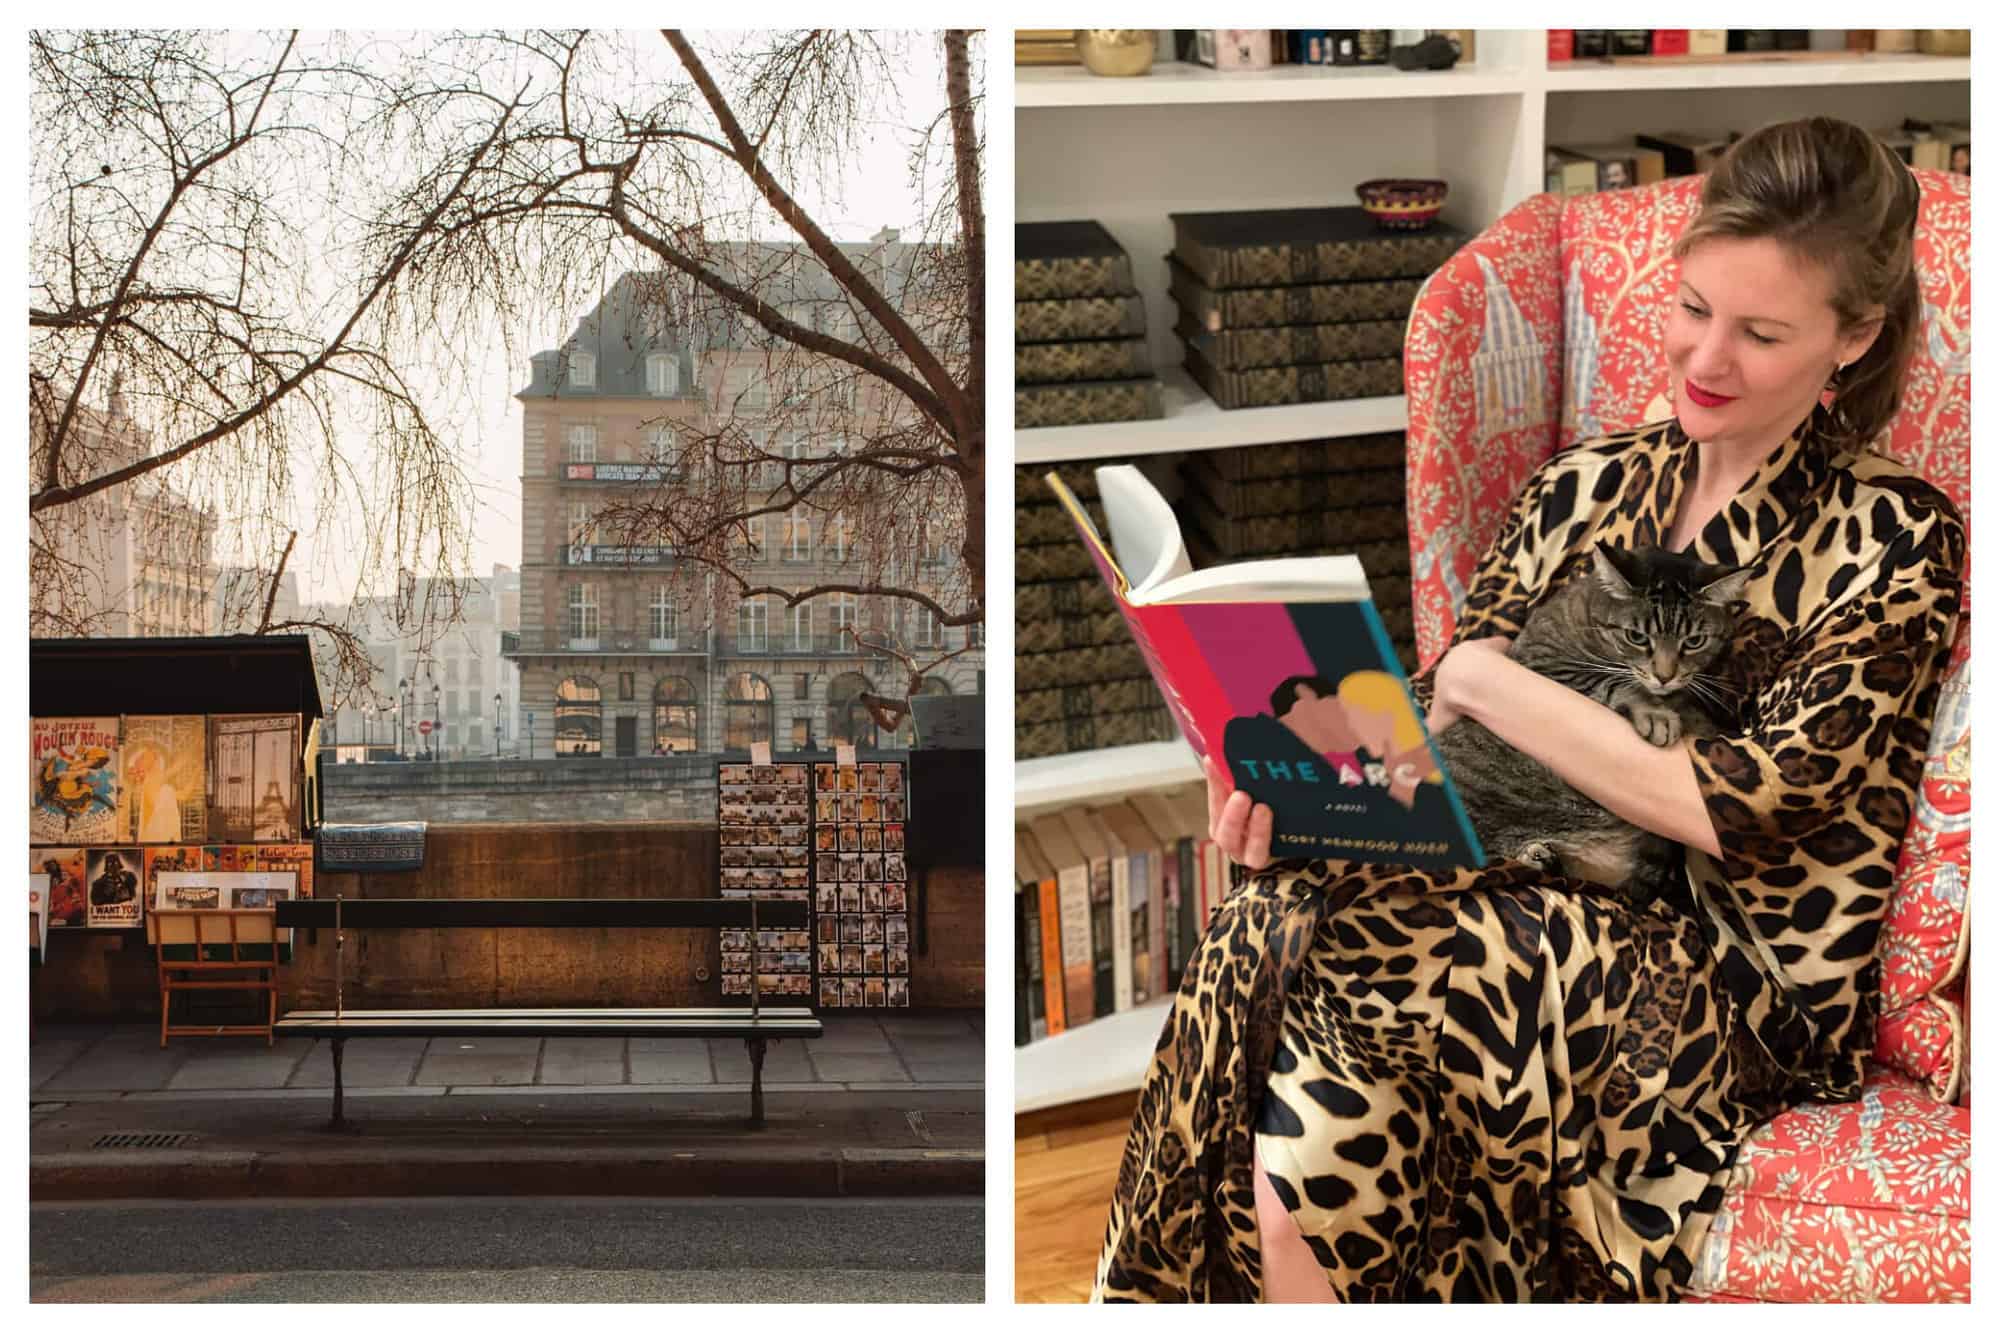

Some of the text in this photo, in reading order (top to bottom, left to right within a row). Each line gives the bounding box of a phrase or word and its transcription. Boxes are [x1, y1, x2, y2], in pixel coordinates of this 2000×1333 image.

[33, 731, 77, 760] MOULIN
[80, 731, 119, 752] ROUGE
[1240, 760, 1423, 789] THE ARC
[96, 905, 120, 914] WANT
[120, 904, 140, 914] YOU
